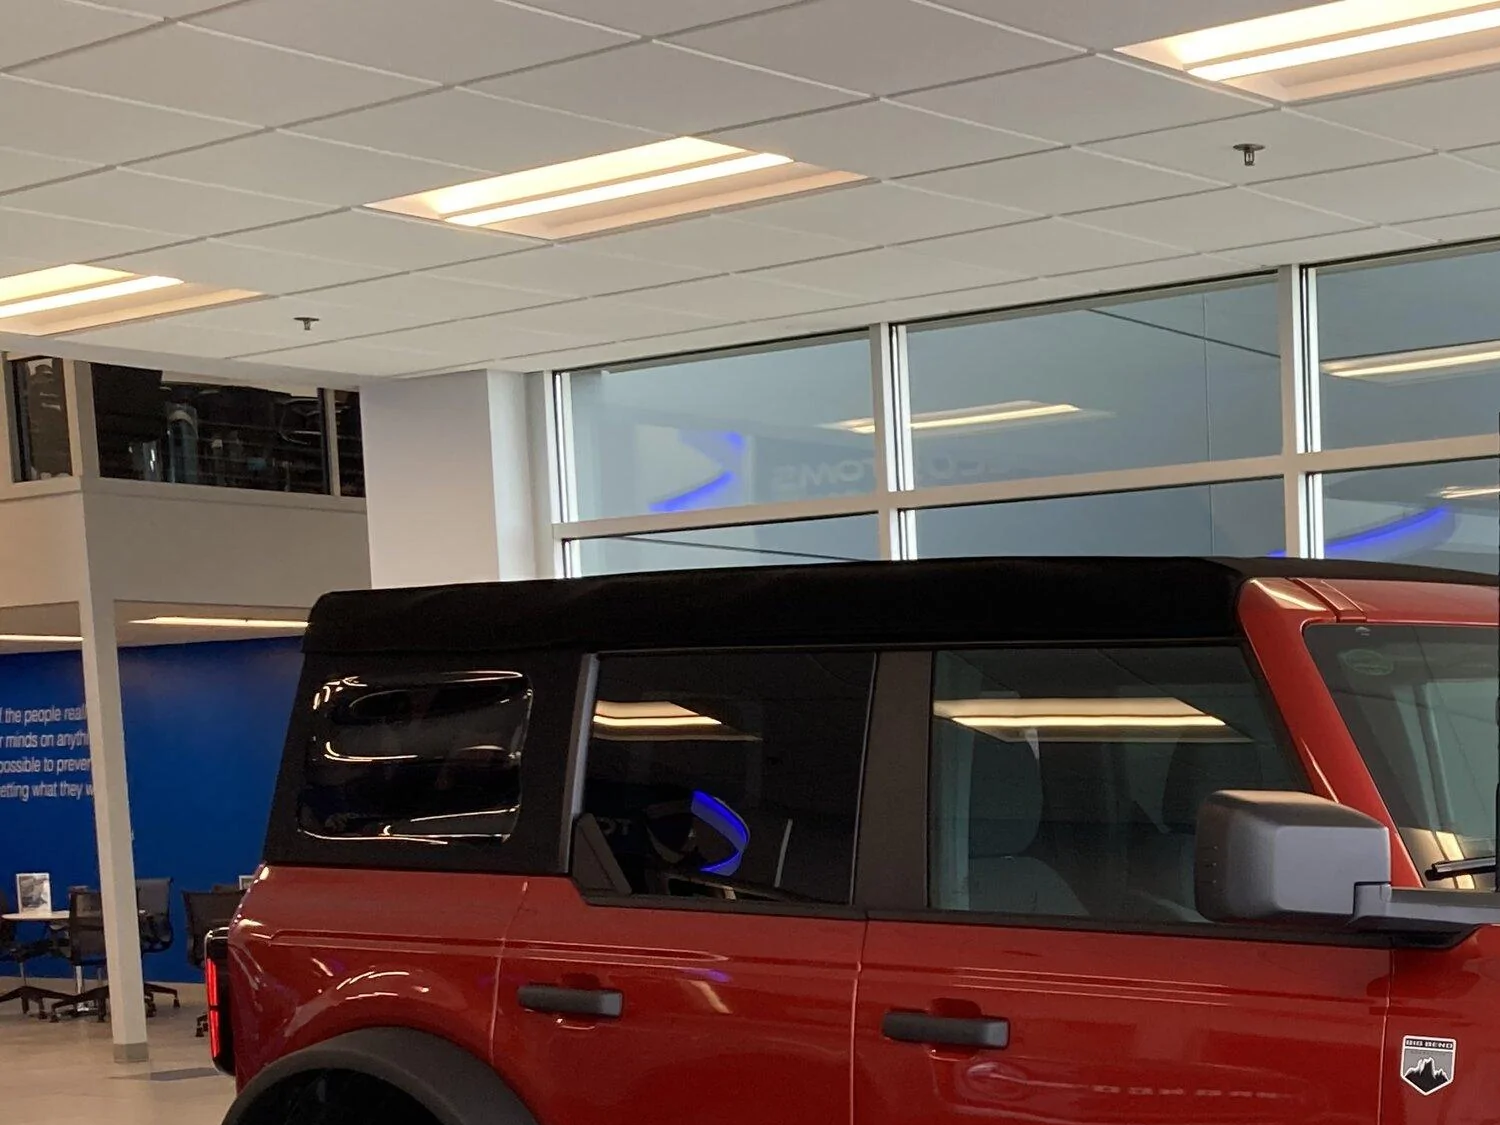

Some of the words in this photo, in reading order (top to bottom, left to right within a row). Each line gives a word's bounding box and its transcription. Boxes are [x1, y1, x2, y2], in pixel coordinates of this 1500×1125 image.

[5, 707, 21, 723] the
[24, 705, 61, 726] people
[6, 731, 38, 748] minds
[40, 734, 54, 747] on
[44, 757, 54, 772] to
[32, 781, 57, 797] what
[60, 780, 83, 800] they
[1425, 1041, 1453, 1049] BEND
